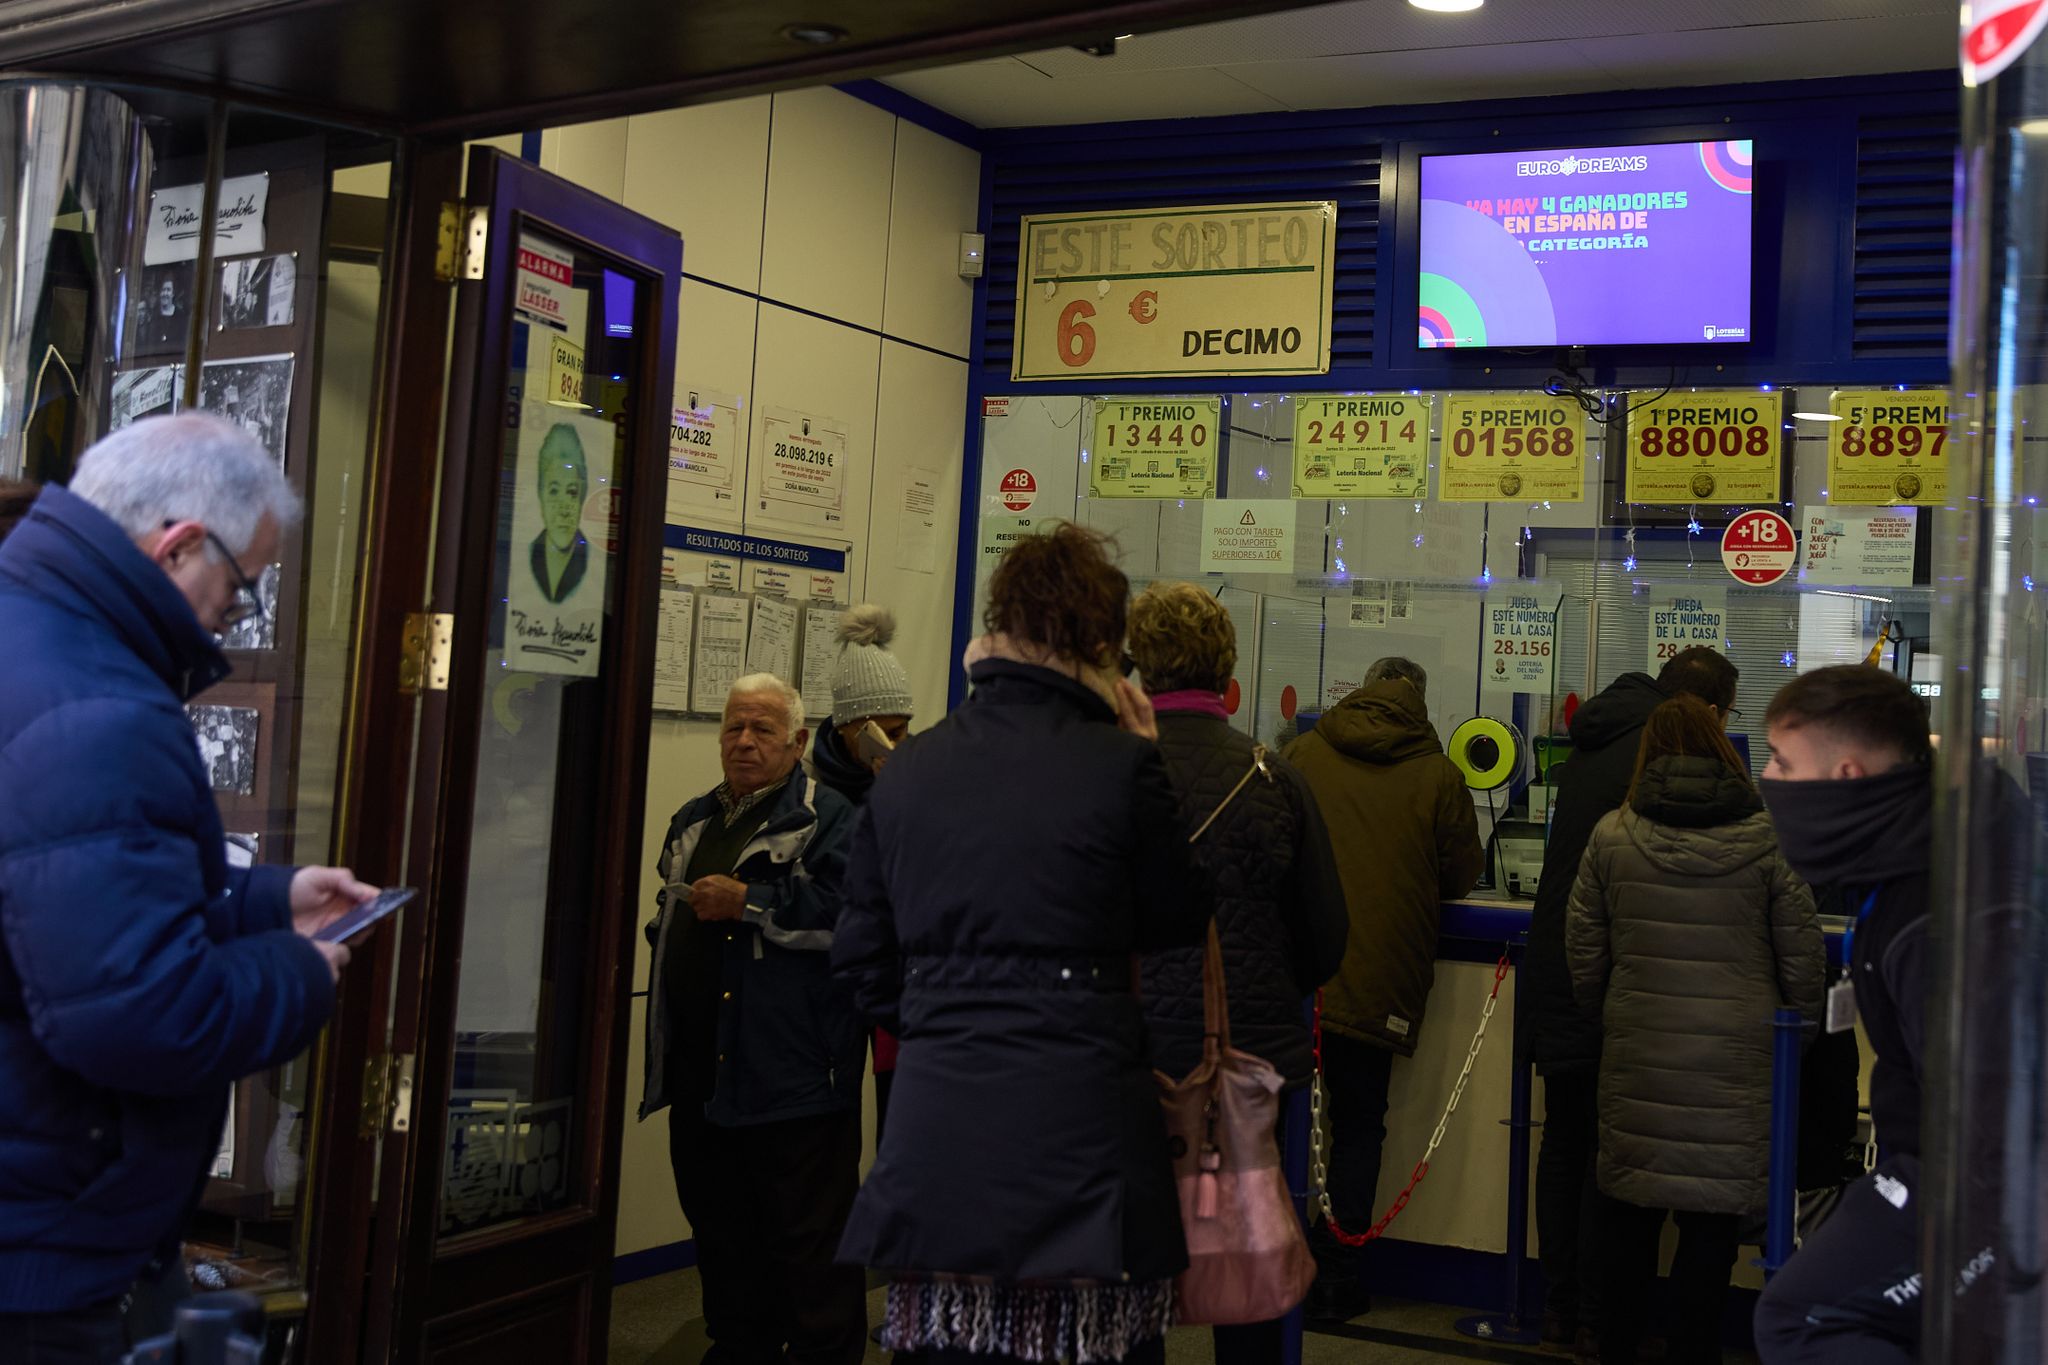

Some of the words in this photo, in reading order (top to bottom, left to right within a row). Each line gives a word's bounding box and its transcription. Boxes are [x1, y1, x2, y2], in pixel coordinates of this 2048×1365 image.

[1578, 156, 1648, 174] DREAMS
[1497, 198, 1539, 215] HAY
[1542, 197, 1555, 213] 4
[1560, 191, 1688, 213] GANADORES
[1504, 216, 1530, 234] EN
[1535, 209, 1615, 233] ESPAÑA
[1620, 211, 1648, 230] DE
[1035, 222, 1132, 276] ESTE
[1151, 216, 1309, 271] SORTEO
[1528, 233, 1648, 252] CATEGORÍA
[520, 252, 565, 282] ALARMA
[523, 288, 560, 313] LASSER
[1057, 300, 1097, 367] 6
[1128, 290, 1158, 324] €
[1182, 326, 1301, 358] DECIMO
[556, 349, 576, 370] GRAN
[1133, 406, 1195, 421] PREMIO
[1337, 401, 1404, 417] PREMIO
[1480, 409, 1566, 427] PREMIO
[1667, 407, 1758, 425] PREMIO
[1872, 406, 1949, 424] PREMI
[1107, 424, 1207, 447] 13440
[1307, 419, 1416, 444] 24914
[1453, 427, 1574, 457] 01568
[1640, 425, 1769, 458] 88008
[1841, 425, 1949, 457] 8897
[775, 442, 825, 466] 28.098.219
[828, 453, 834, 467] €
[1007, 473, 1029, 487] +18
[1018, 519, 1031, 527] NO
[1738, 519, 1778, 543] +18
[1213, 528, 1234, 536] PAGO
[1235, 528, 1252, 536] CON
[1254, 528, 1283, 537] TARJETA
[686, 533, 741, 552] RESULTADOS
[743, 542, 754, 553] DE
[756, 544, 772, 557] LOS
[773, 546, 809, 562] SORTEOS
[1218, 538, 1238, 547] SOLO
[1239, 538, 1277, 547] IMPORTES
[1212, 550, 1257, 559] SUPERIORES
[1257, 551, 1264, 559] A
[1266, 550, 1282, 559] 10€
[1509, 597, 1539, 610] JUEGA
[1672, 599, 1703, 612] JUEGA
[1492, 610, 1514, 622] ESTE
[1516, 608, 1556, 624] NÚMERO
[1655, 612, 1677, 625] ESTE
[1680, 610, 1720, 626] NÚMERO
[1494, 623, 1505, 635] DE
[1511, 624, 1522, 636] LA
[1528, 624, 1552, 637] CASA
[1656, 626, 1668, 638] DE
[1674, 626, 1685, 638] LA
[1692, 627, 1718, 639] CASA
[1494, 639, 1550, 657] 28.156
